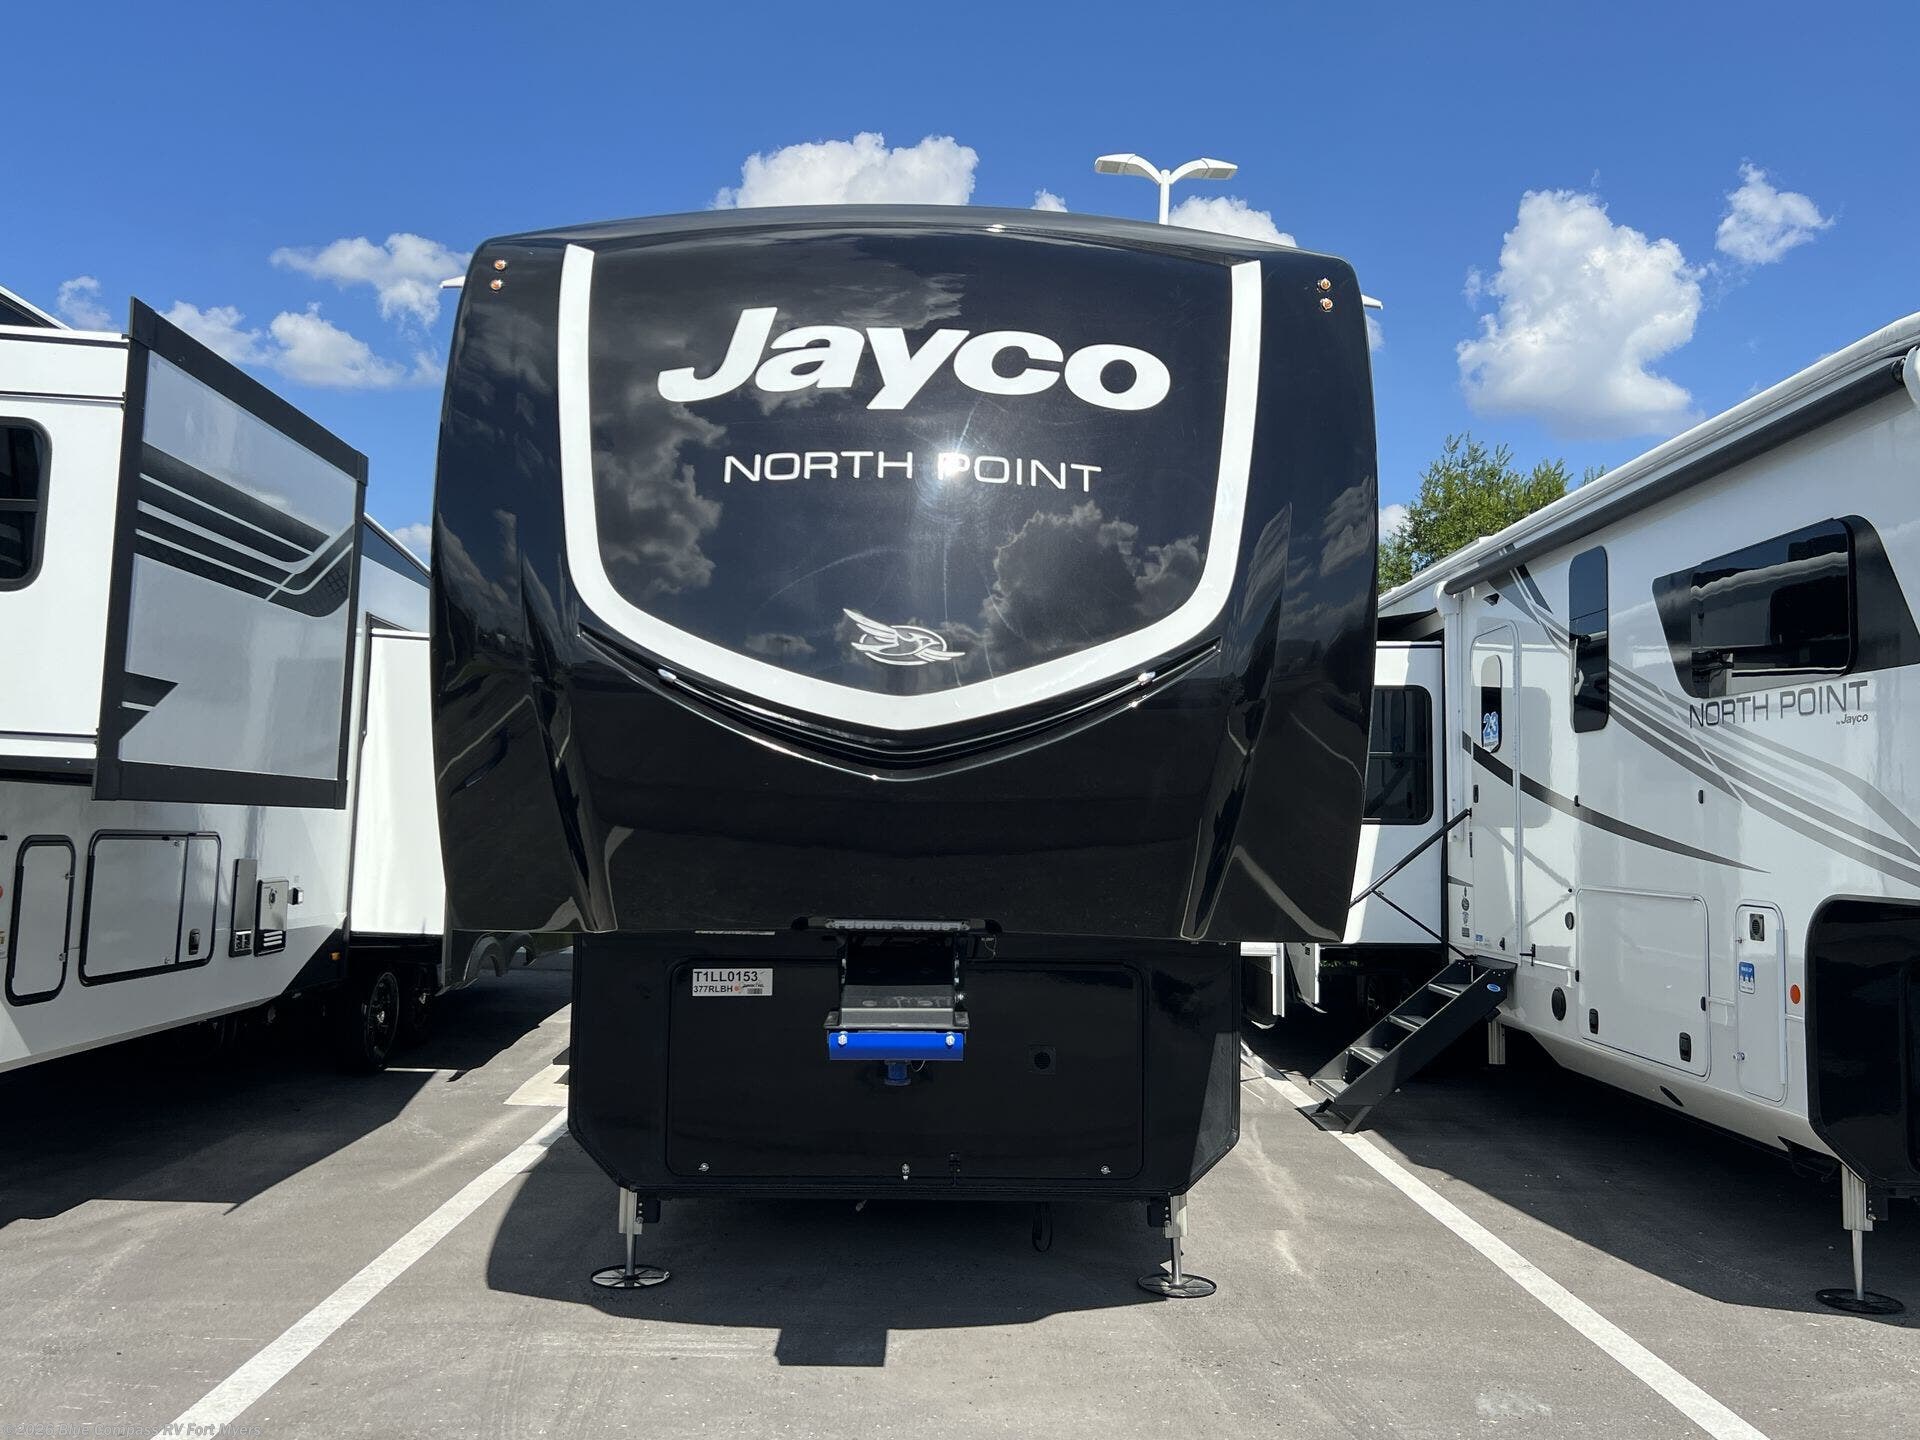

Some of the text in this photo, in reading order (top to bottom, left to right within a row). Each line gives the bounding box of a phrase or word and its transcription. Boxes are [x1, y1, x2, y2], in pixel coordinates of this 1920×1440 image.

[657, 306, 1171, 411] Jayco
[723, 450, 1102, 493] NORTH POINT
[1689, 680, 1868, 729] NORTH POINT
[1841, 714, 1869, 725] Jayco
[694, 971, 758, 982] T1LL0153
[694, 985, 733, 993] 377RLBH
